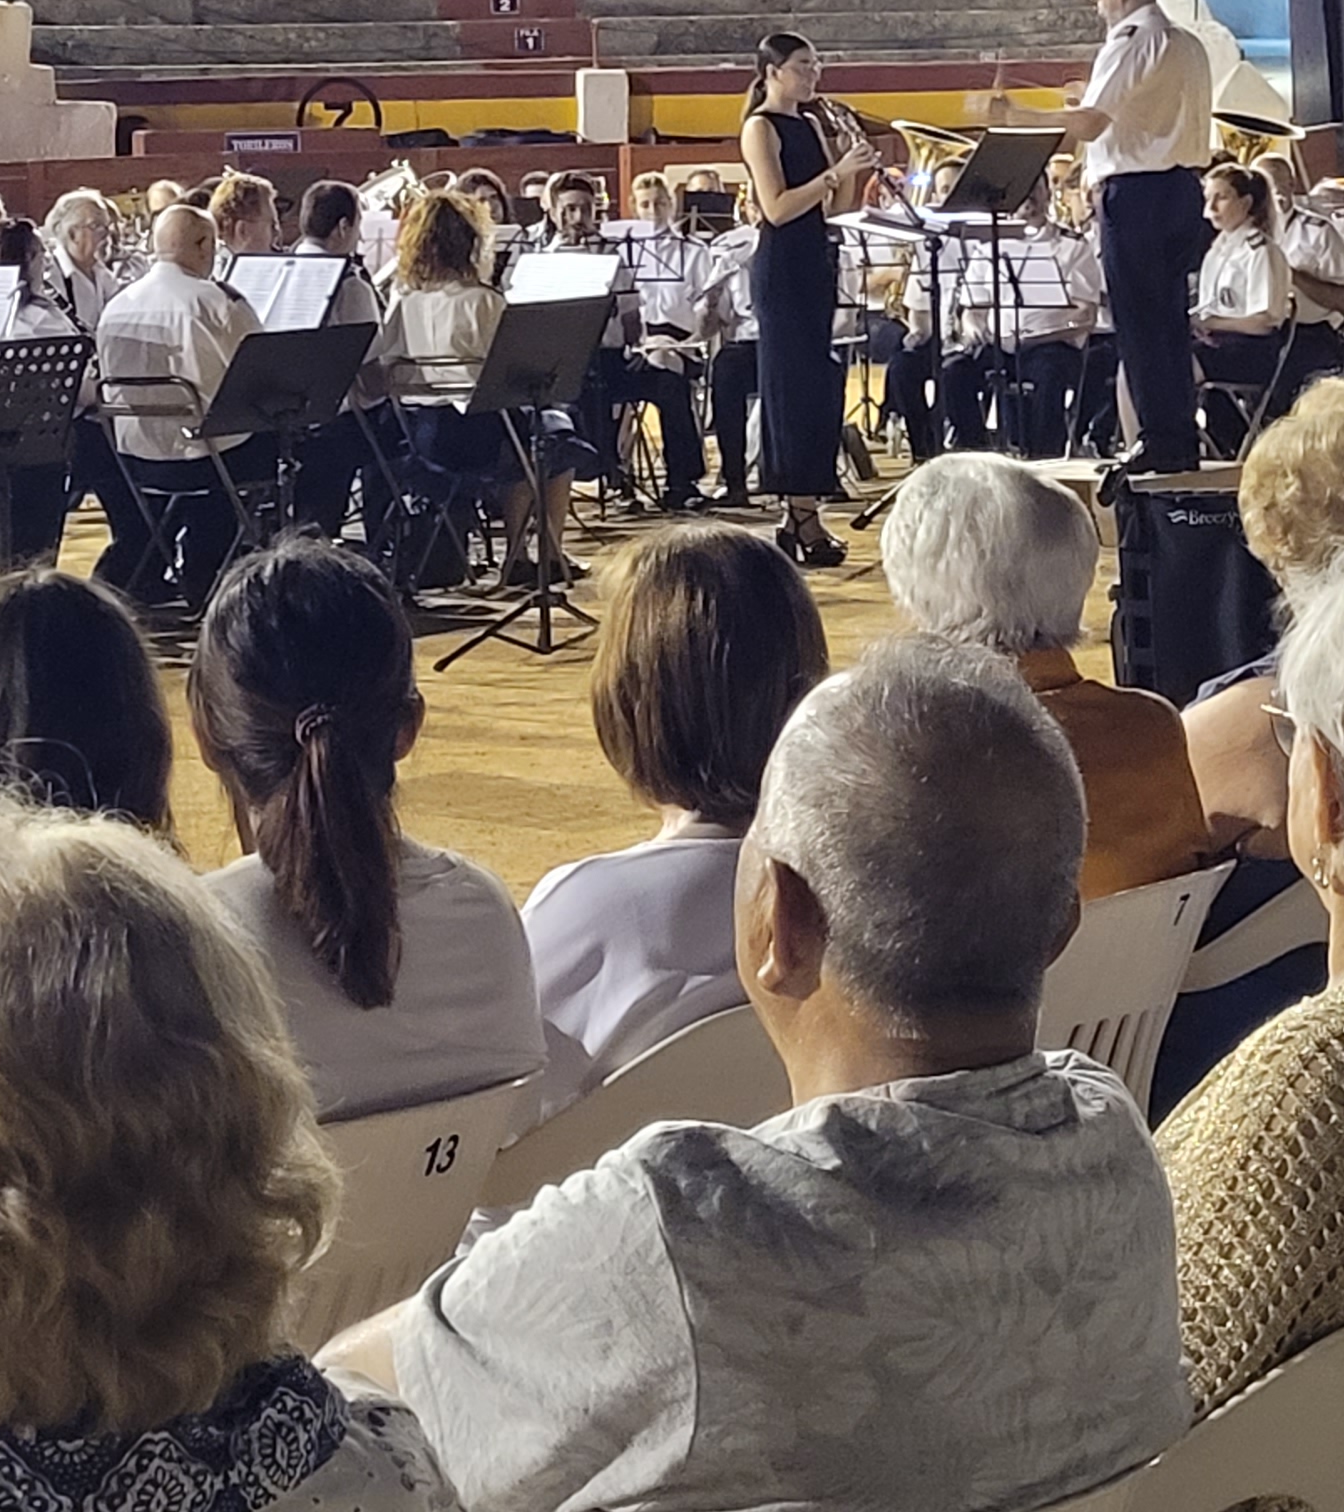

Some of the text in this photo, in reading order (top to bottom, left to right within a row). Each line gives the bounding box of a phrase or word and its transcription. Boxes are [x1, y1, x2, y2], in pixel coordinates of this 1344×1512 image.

[526, 37, 534, 50] 1
[323, 101, 354, 128] 7
[424, 1134, 459, 1177] 13
